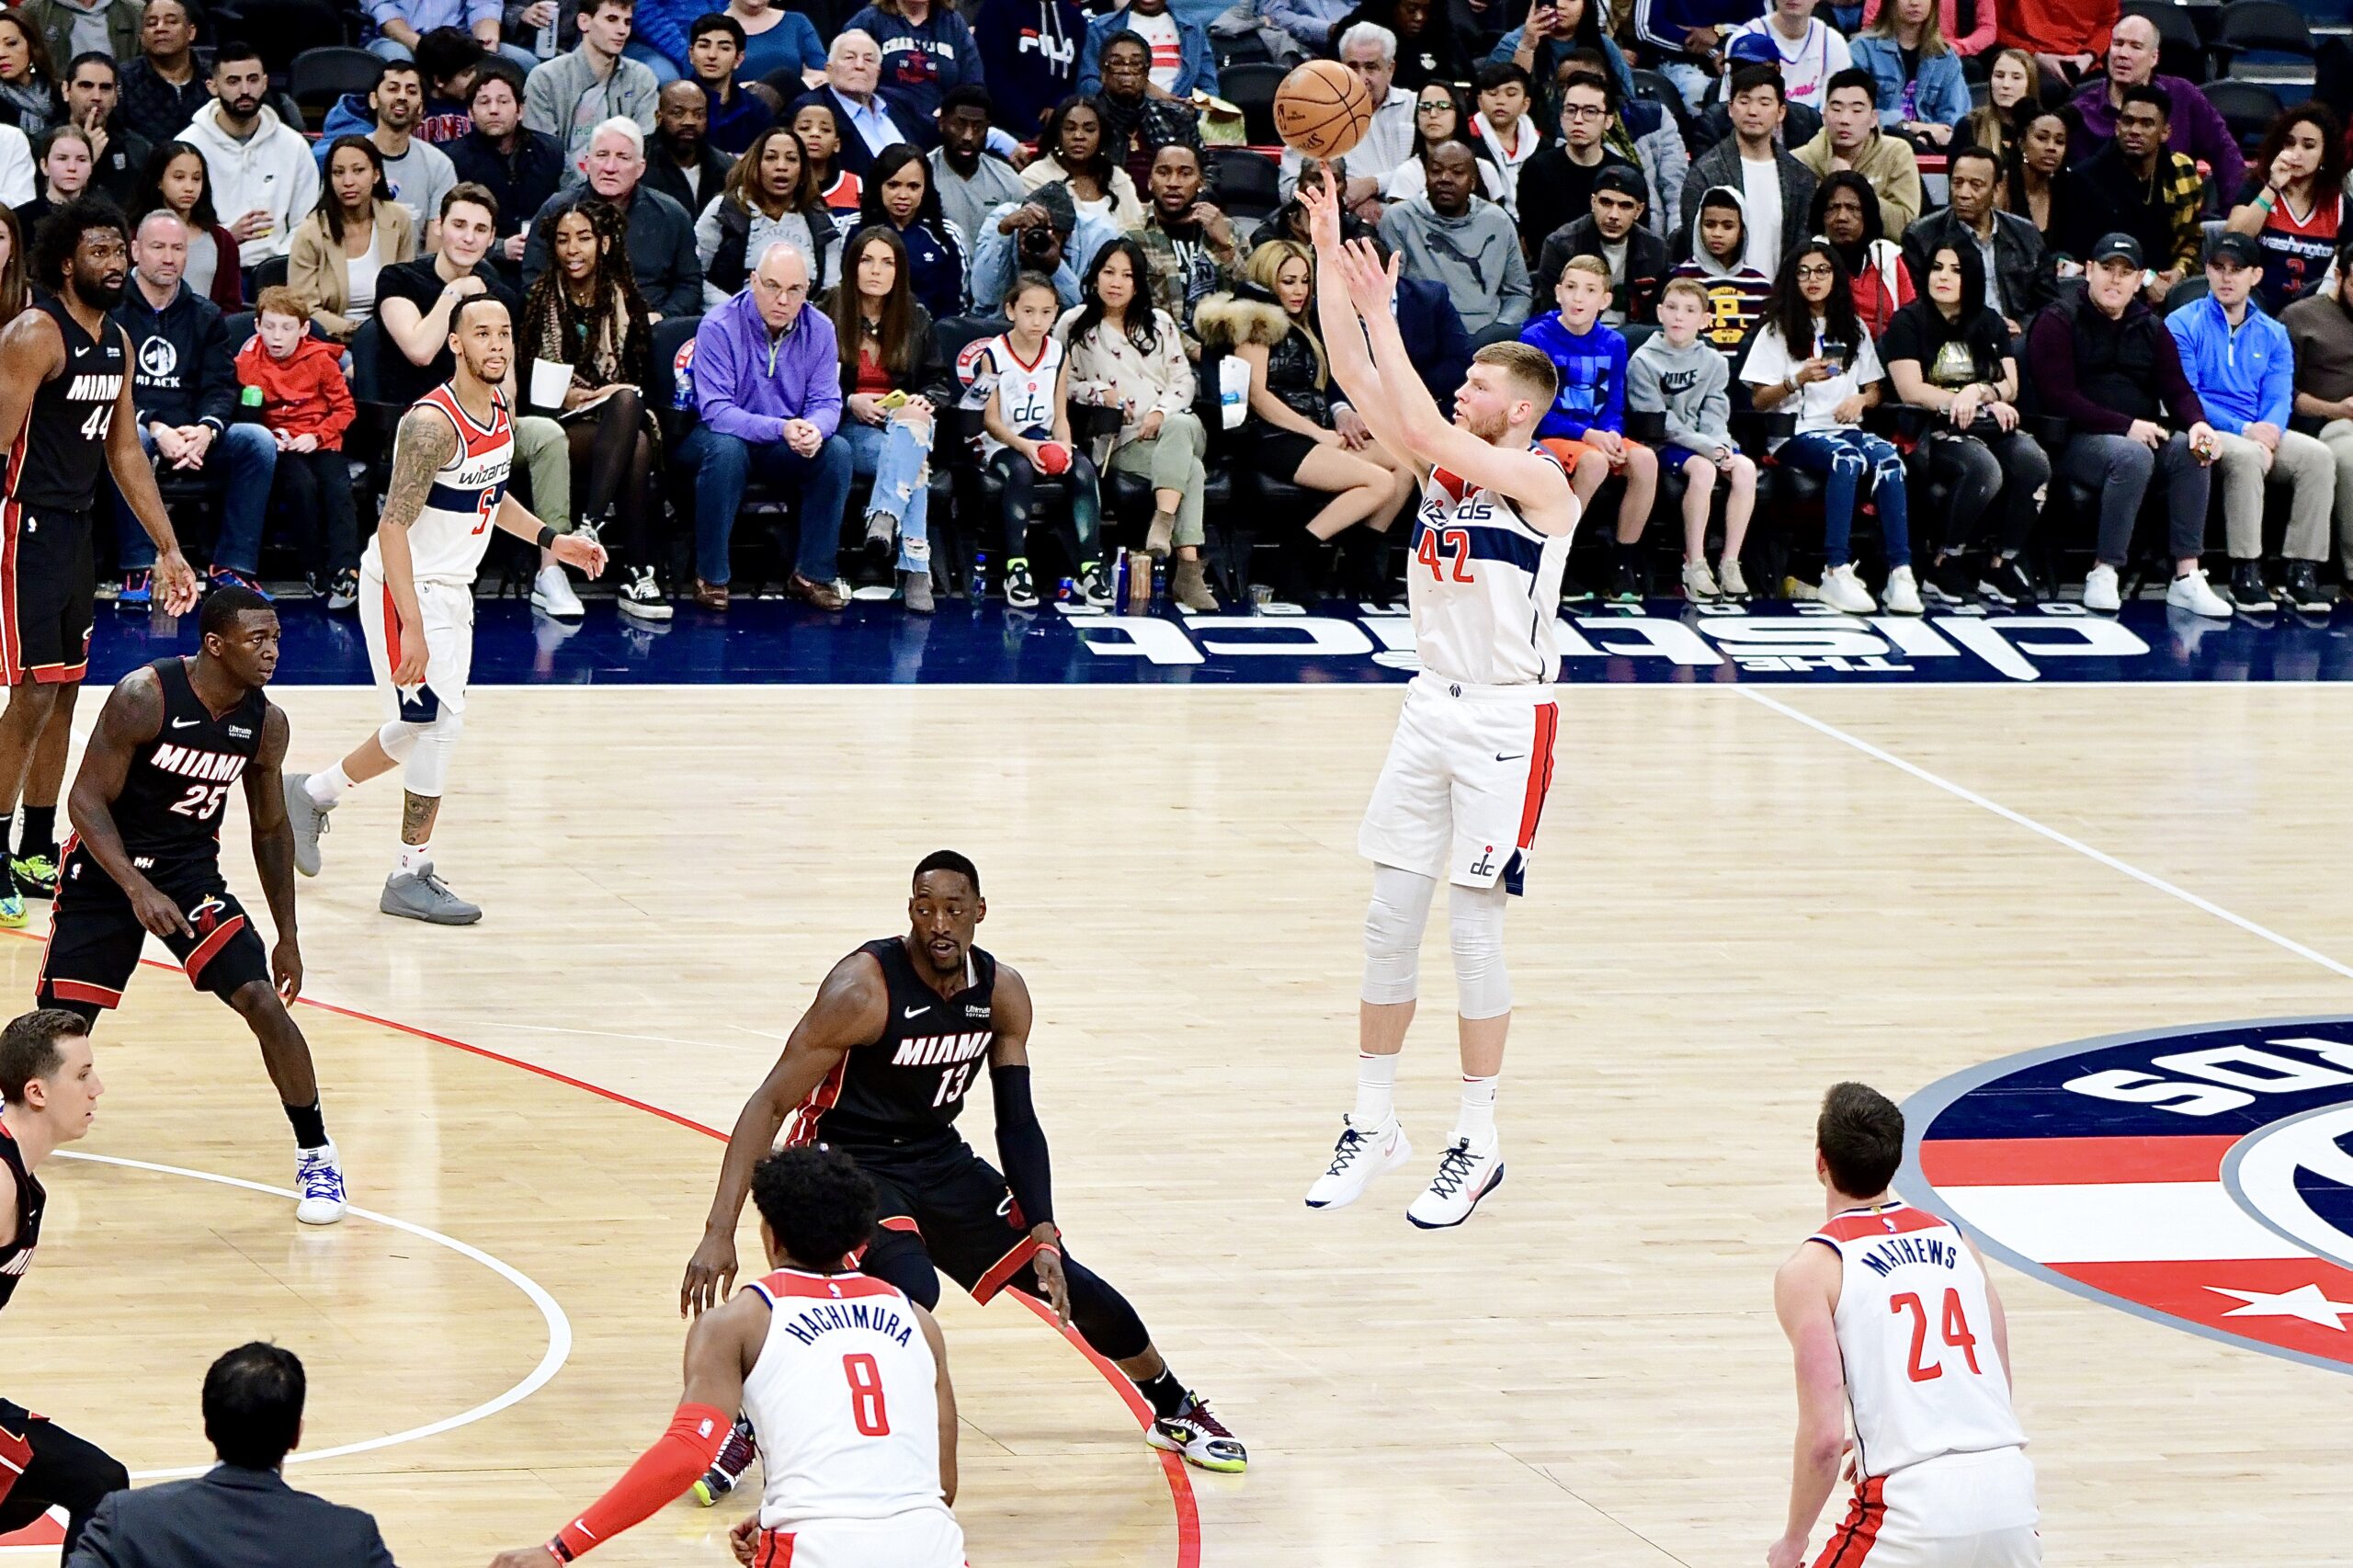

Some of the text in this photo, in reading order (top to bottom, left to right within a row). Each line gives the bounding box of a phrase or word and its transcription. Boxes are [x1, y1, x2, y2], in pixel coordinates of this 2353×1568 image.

[1018, 34, 1074, 64] FILA
[2282, 258, 2305, 293] 3
[1665, 369, 1698, 384] NIKE
[81, 404, 115, 440] 44
[471, 486, 495, 535] 5
[1417, 528, 1475, 583] 42
[1733, 655, 1915, 672] THE
[150, 743, 247, 782] MIAMI
[169, 785, 228, 820] 25
[891, 1031, 993, 1066] MIAMI
[932, 1062, 971, 1108] 13
[1860, 1237, 1958, 1278] MATHEWS
[784, 1303, 914, 1348] HACHIMURA
[1889, 1287, 1983, 1383] 24
[842, 1352, 891, 1437] 8
